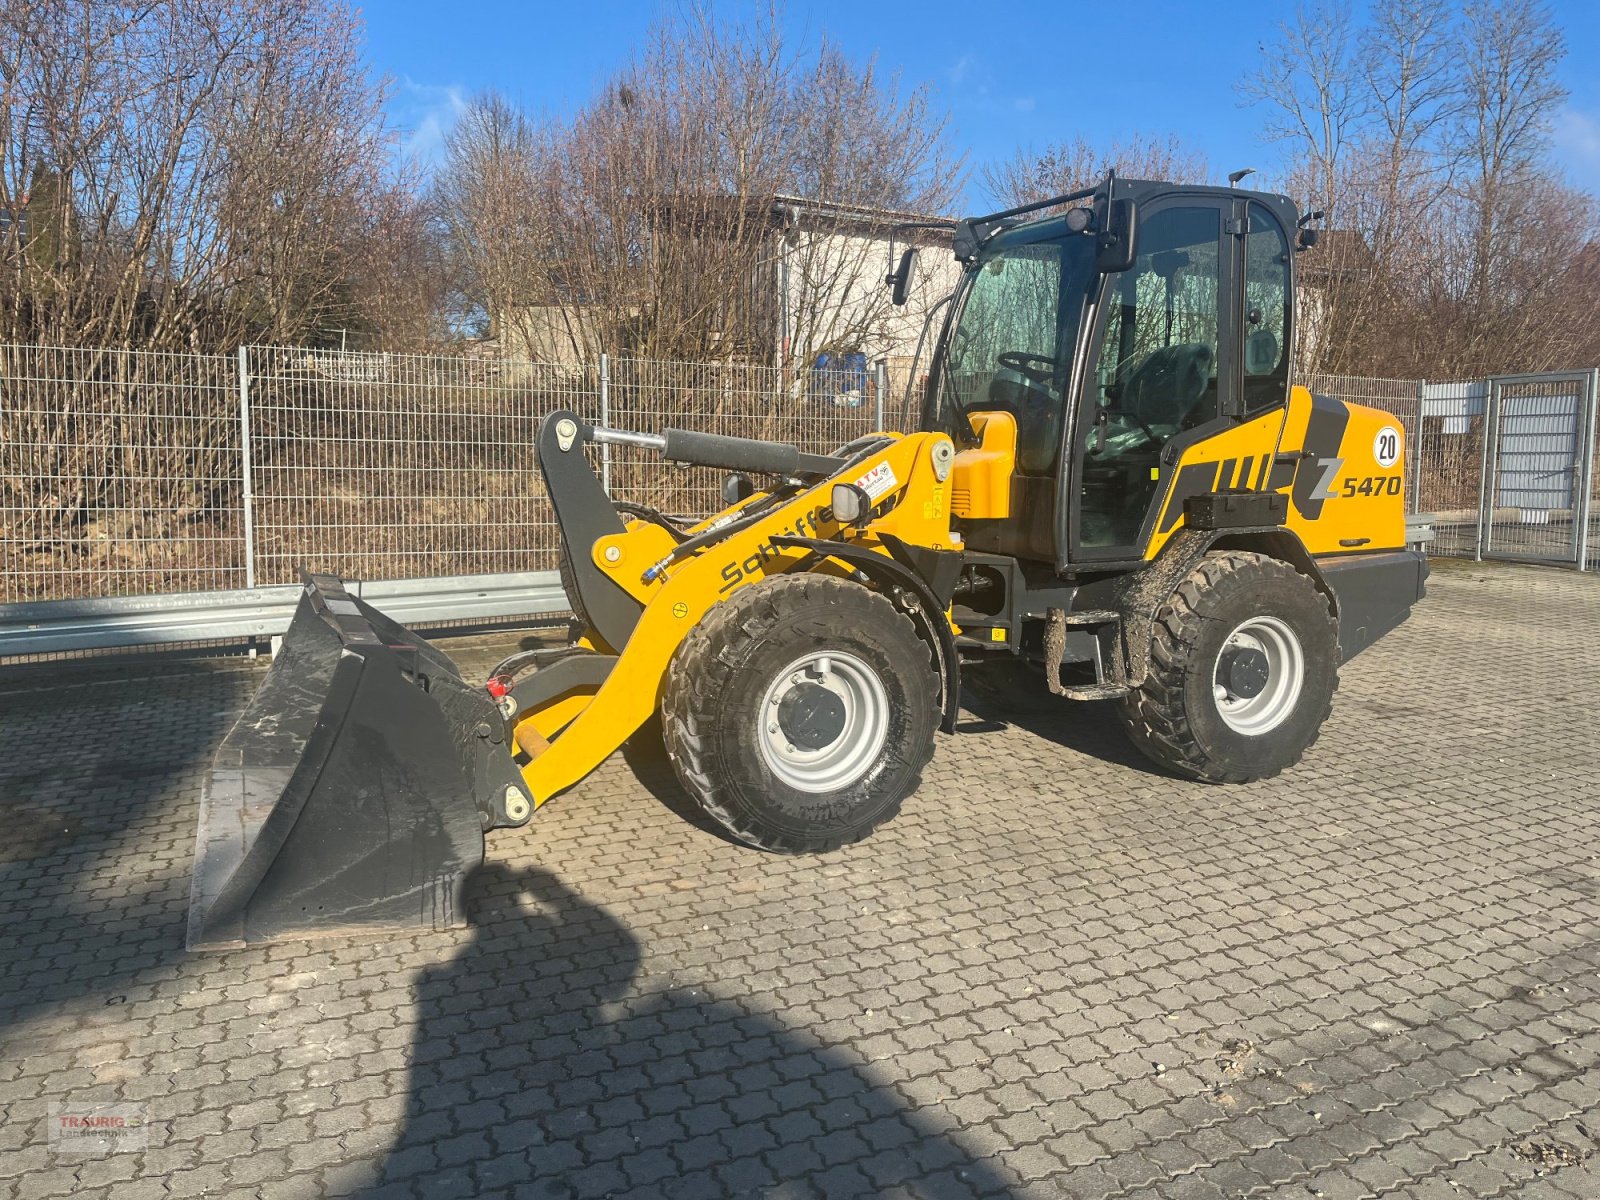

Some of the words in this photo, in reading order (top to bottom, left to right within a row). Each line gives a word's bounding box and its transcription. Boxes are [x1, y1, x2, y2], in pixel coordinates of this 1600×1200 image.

[1379, 434, 1396, 460] 20
[1342, 476, 1402, 498] 5470
[718, 504, 834, 594] Schffe
